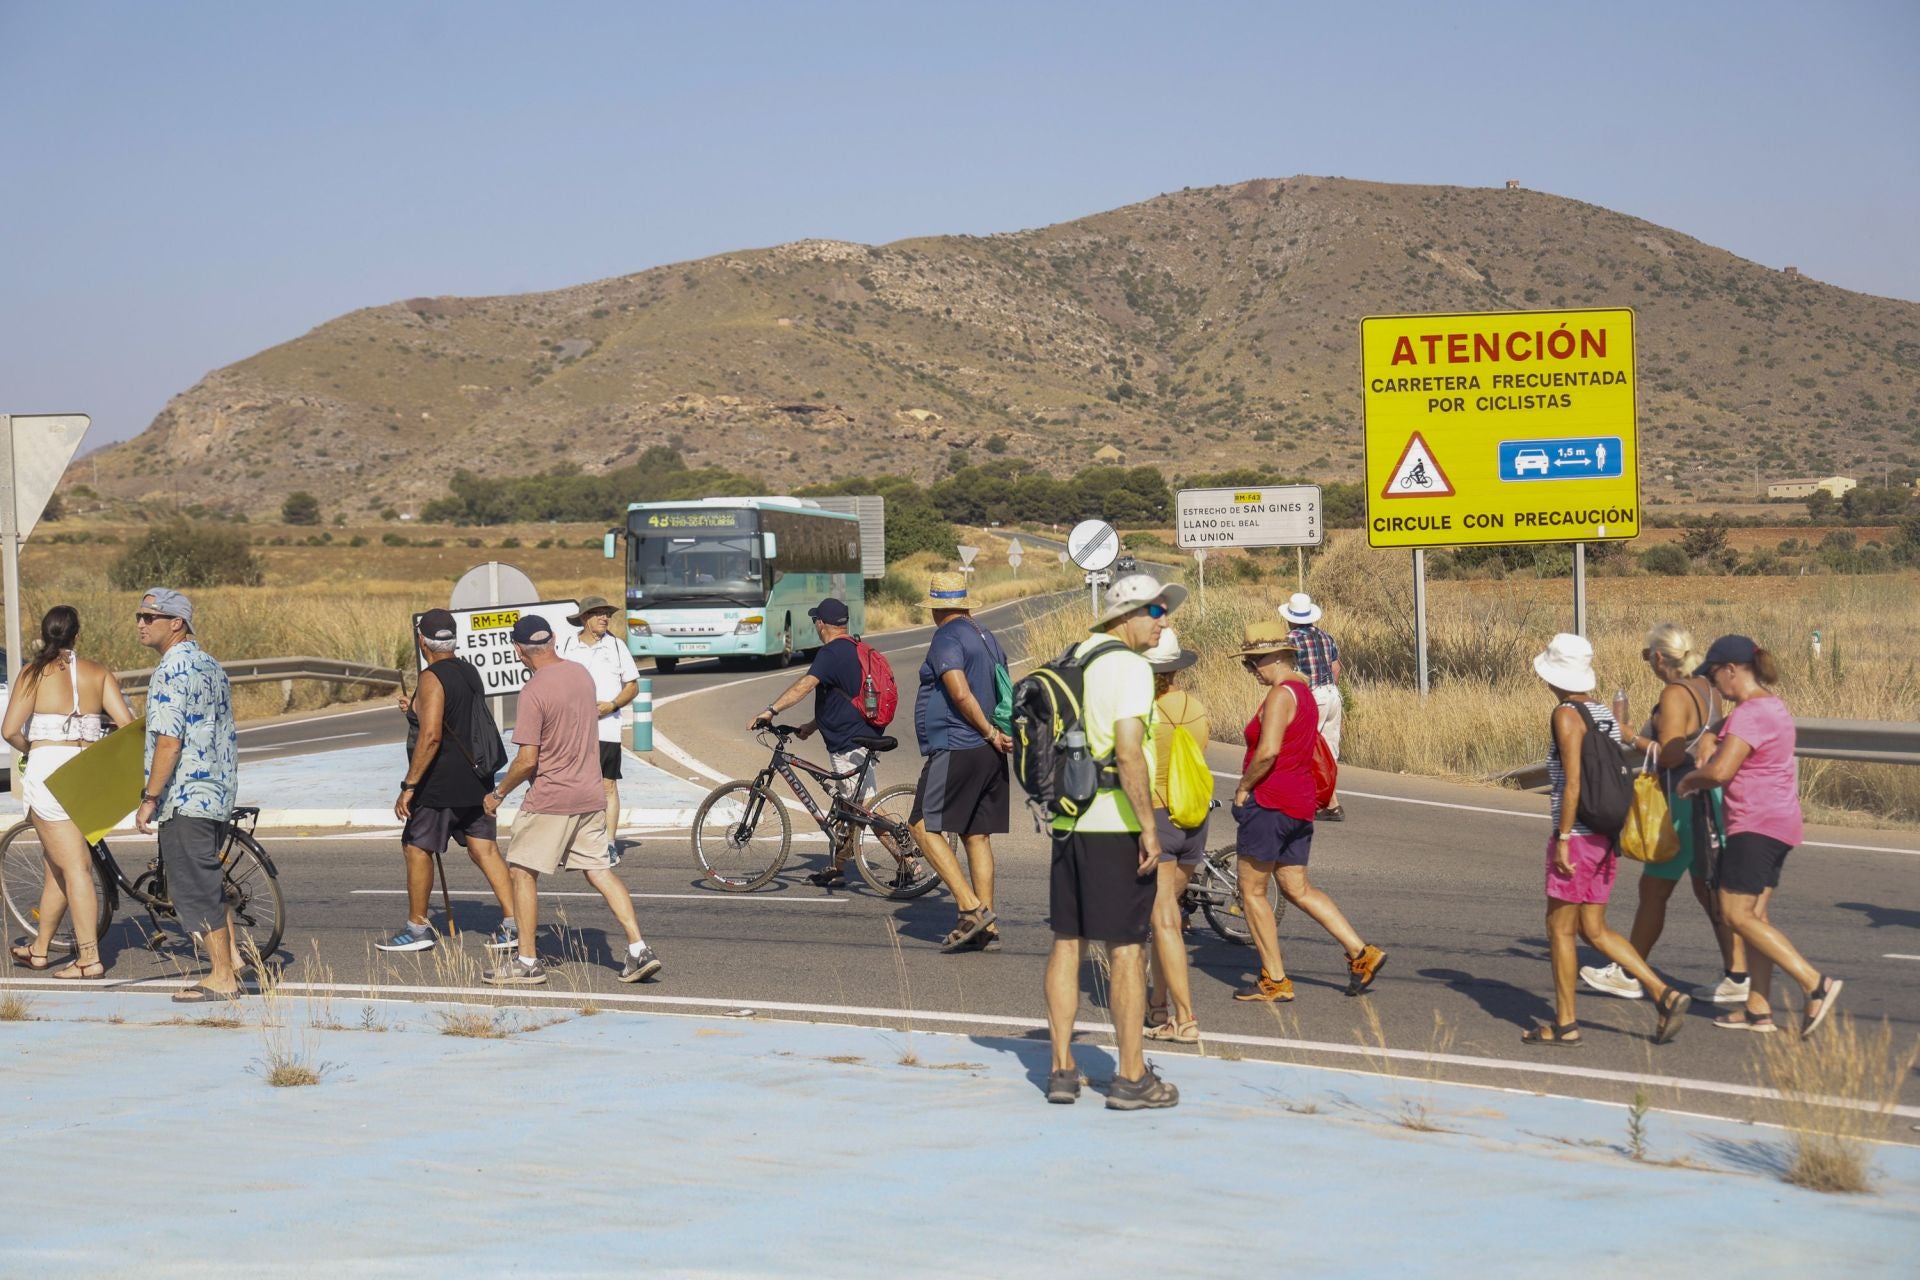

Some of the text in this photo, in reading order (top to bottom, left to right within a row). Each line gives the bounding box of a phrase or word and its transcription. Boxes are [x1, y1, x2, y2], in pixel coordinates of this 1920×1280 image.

[1391, 322, 1607, 366] ATENCIÓN
[1371, 370, 1627, 393] CARRETERA FRECUENTADA
[1428, 393, 1572, 413] POR CICLISTAS
[1557, 447, 1586, 458] 1,5 m
[1183, 507, 1227, 515] ESTRECHO
[1243, 504, 1265, 514] SAN
[1308, 502, 1315, 512] 2
[1183, 516, 1315, 529] LLANO DEL BEAL 3
[1373, 505, 1635, 532] CIRCULE CON PRECAUCIÓN
[1184, 529, 1316, 543] LA UNIÓN 6
